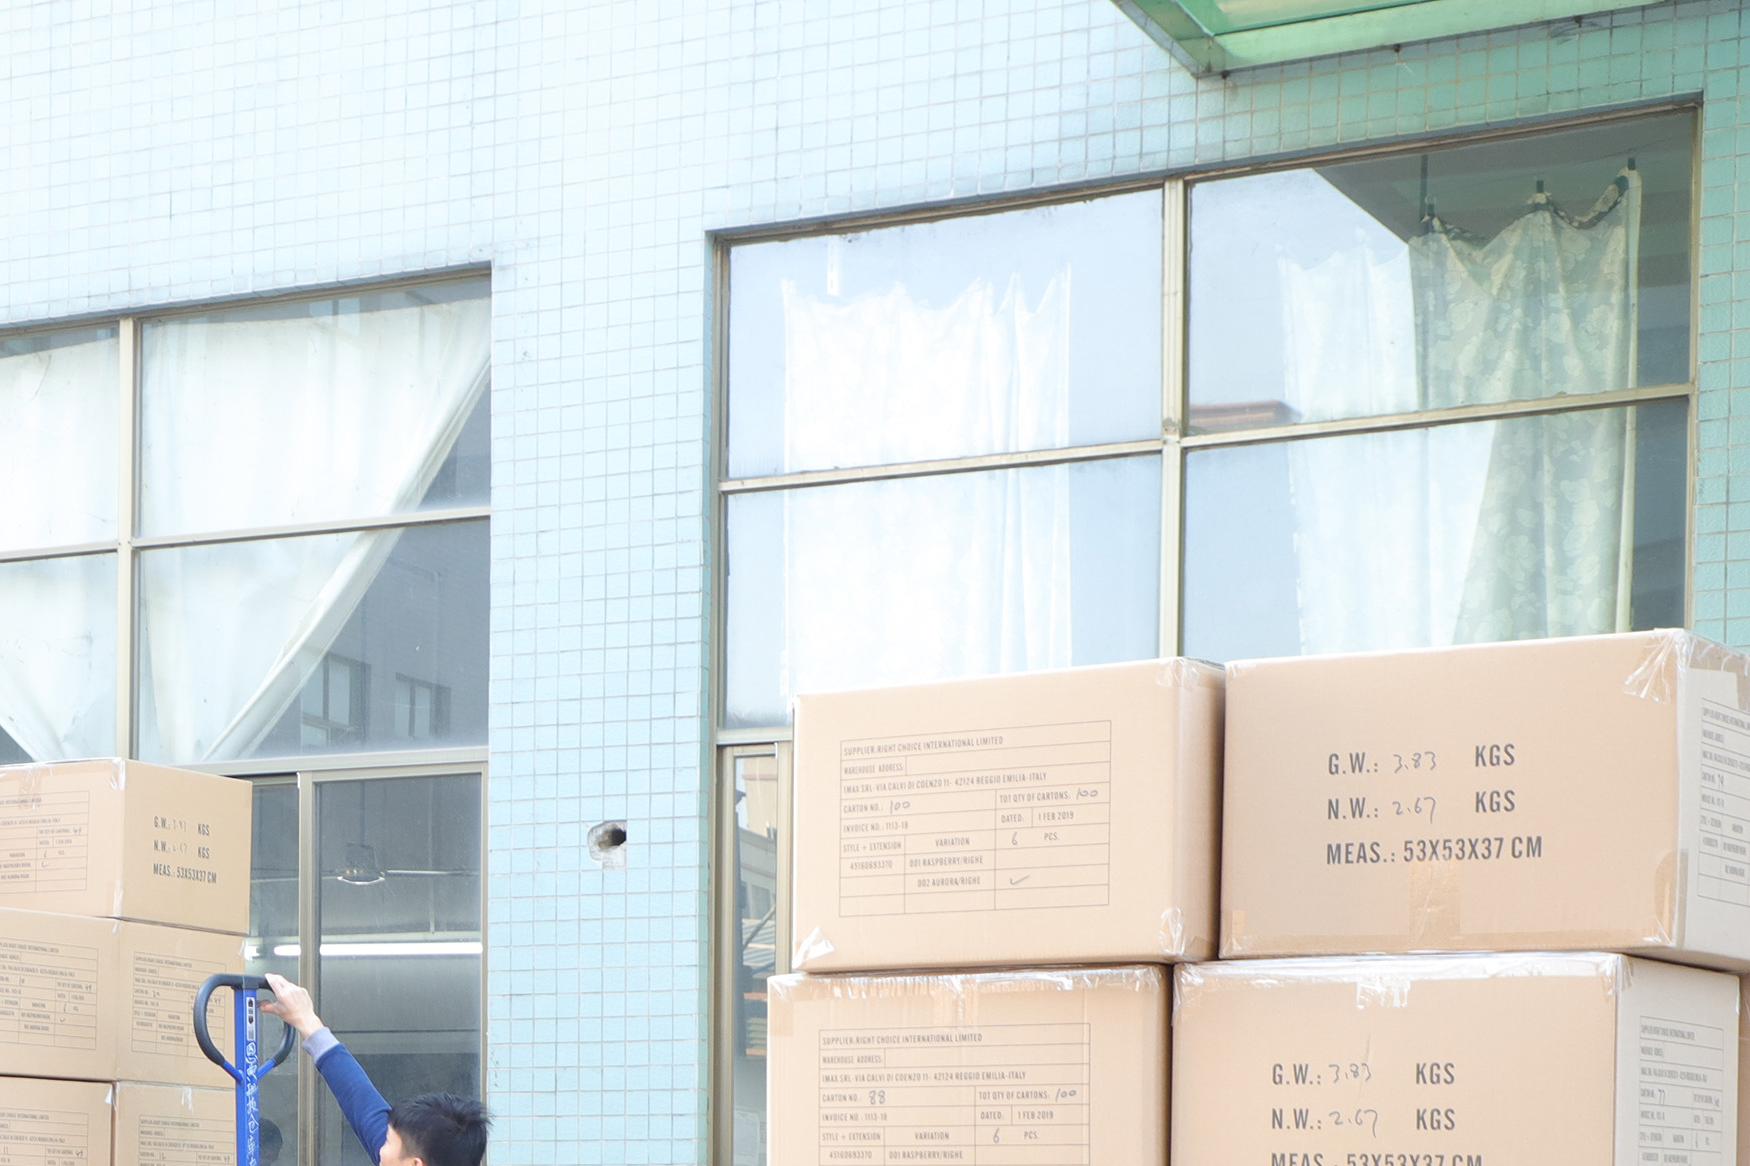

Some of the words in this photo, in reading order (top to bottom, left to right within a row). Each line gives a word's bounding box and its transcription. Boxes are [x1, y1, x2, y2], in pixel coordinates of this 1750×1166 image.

[1328, 753, 1379, 775] G.W.:
[1393, 751, 1437, 773] 3.83
[1475, 743, 1516, 767] KGS
[844, 802, 869, 813] CARTON
[890, 800, 910, 815] 100
[1328, 797, 1379, 820] N.W.:
[1392, 796, 1436, 823] 2.67
[1475, 791, 1516, 812] KGS
[154, 816, 170, 829] G.W.:
[198, 823, 209, 836] KGS
[154, 840, 170, 853] N.W.:
[198, 847, 209, 859] KGS
[1326, 841, 1396, 865] MEAS.:
[1403, 837, 1504, 863] 53X53X37
[1512, 835, 1542, 858] CM
[153, 863, 175, 877] MEAS.:
[177, 866, 206, 881] 53X53X37
[208, 871, 216, 883] CM
[1272, 1063, 1322, 1085] G.W.:
[1329, 1063, 1372, 1083] 3.83
[1416, 1063, 1455, 1084] KGS
[1272, 1109, 1322, 1130] N.W.:
[1329, 1110, 1378, 1138] 2.67
[1416, 1109, 1456, 1130] KGS
